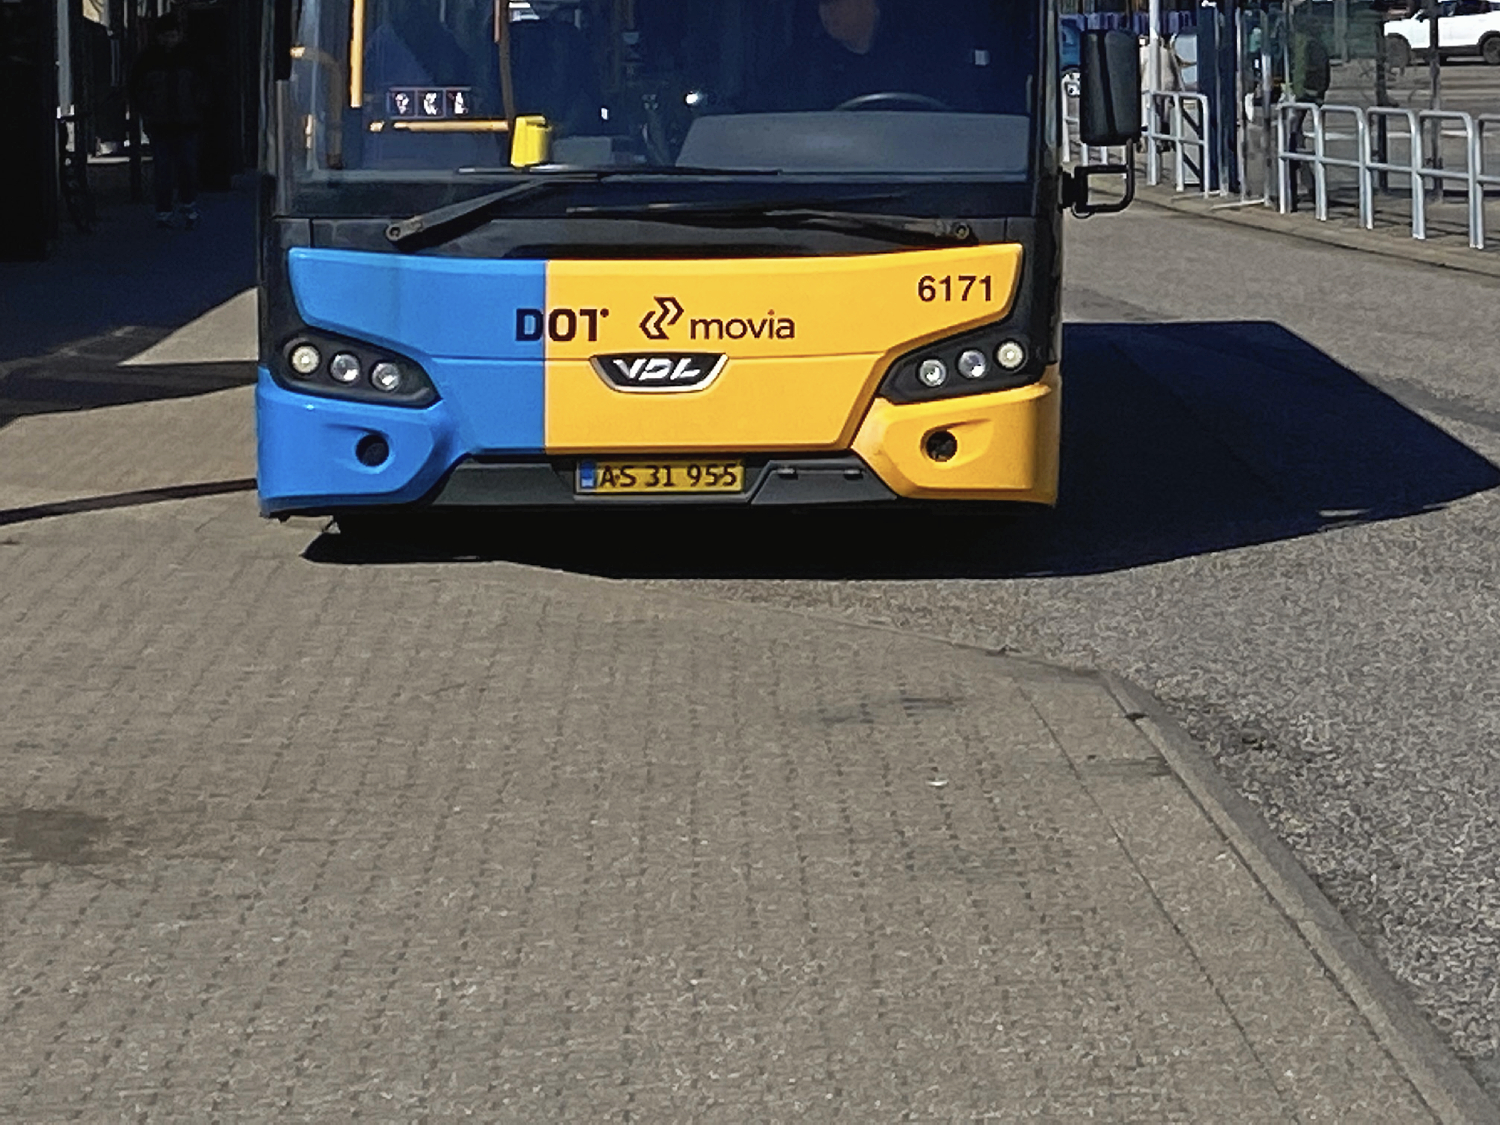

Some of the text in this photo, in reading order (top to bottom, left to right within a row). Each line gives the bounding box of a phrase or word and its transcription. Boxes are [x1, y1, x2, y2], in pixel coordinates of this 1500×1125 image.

[917, 275, 992, 303] 6171
[690, 309, 796, 340] movia
[612, 357, 701, 381] VDL
[601, 463, 738, 488] AS 31 955
